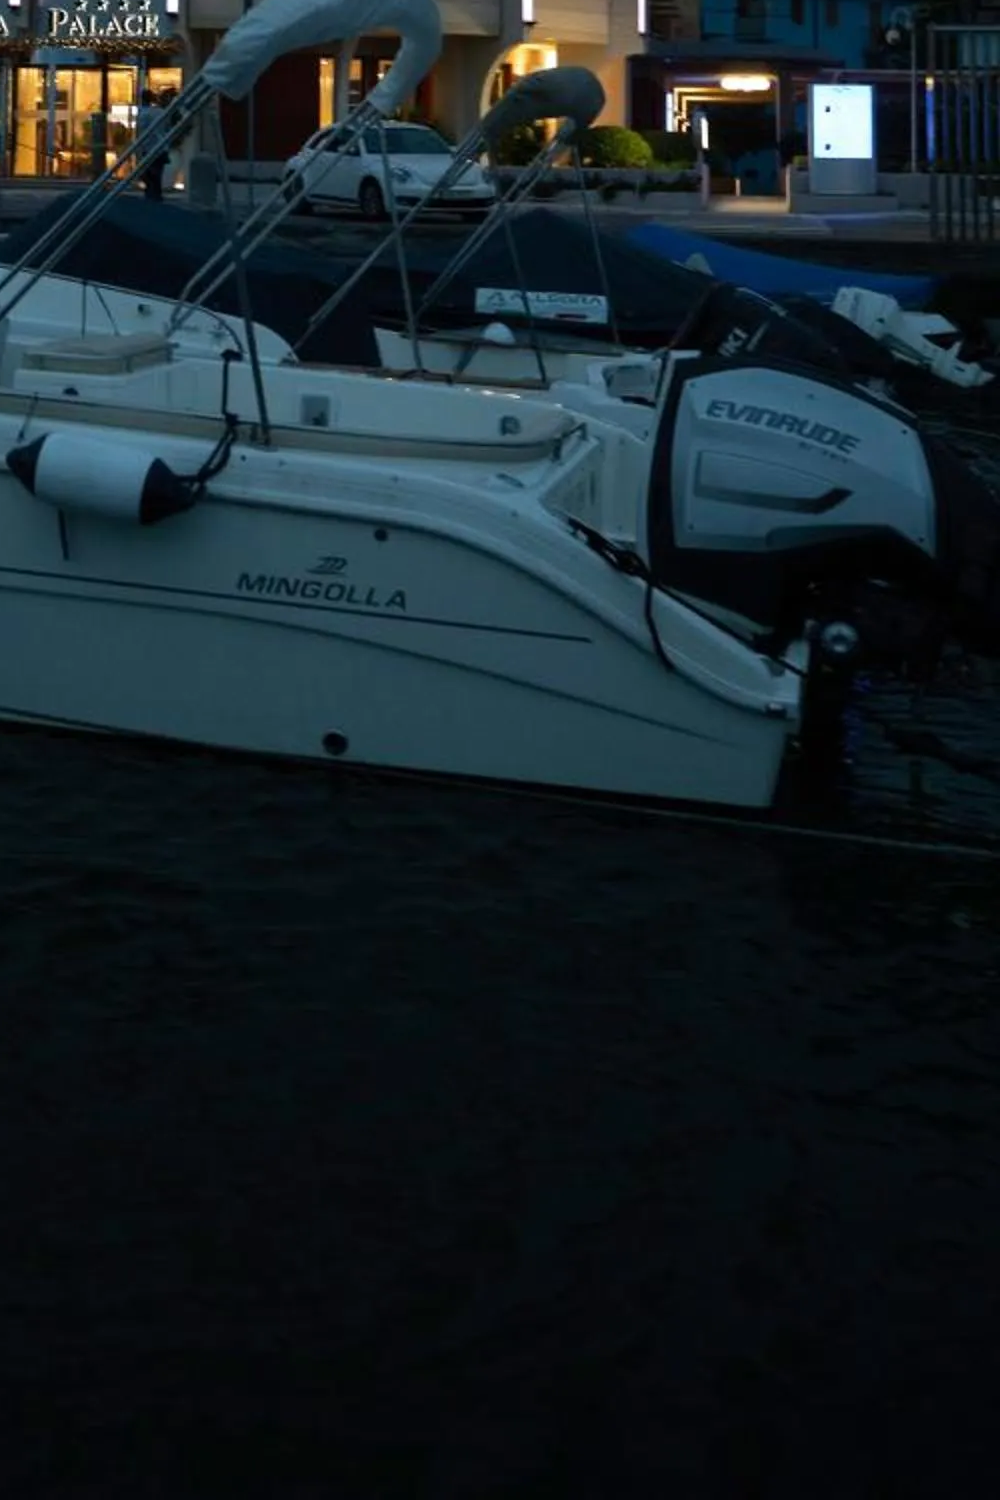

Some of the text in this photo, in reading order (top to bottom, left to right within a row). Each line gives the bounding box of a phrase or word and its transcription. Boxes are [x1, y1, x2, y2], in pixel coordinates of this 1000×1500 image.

[49, 7, 160, 38] PALACE
[706, 399, 861, 454] EVINRUDE
[236, 571, 407, 613] MINGOLLA
